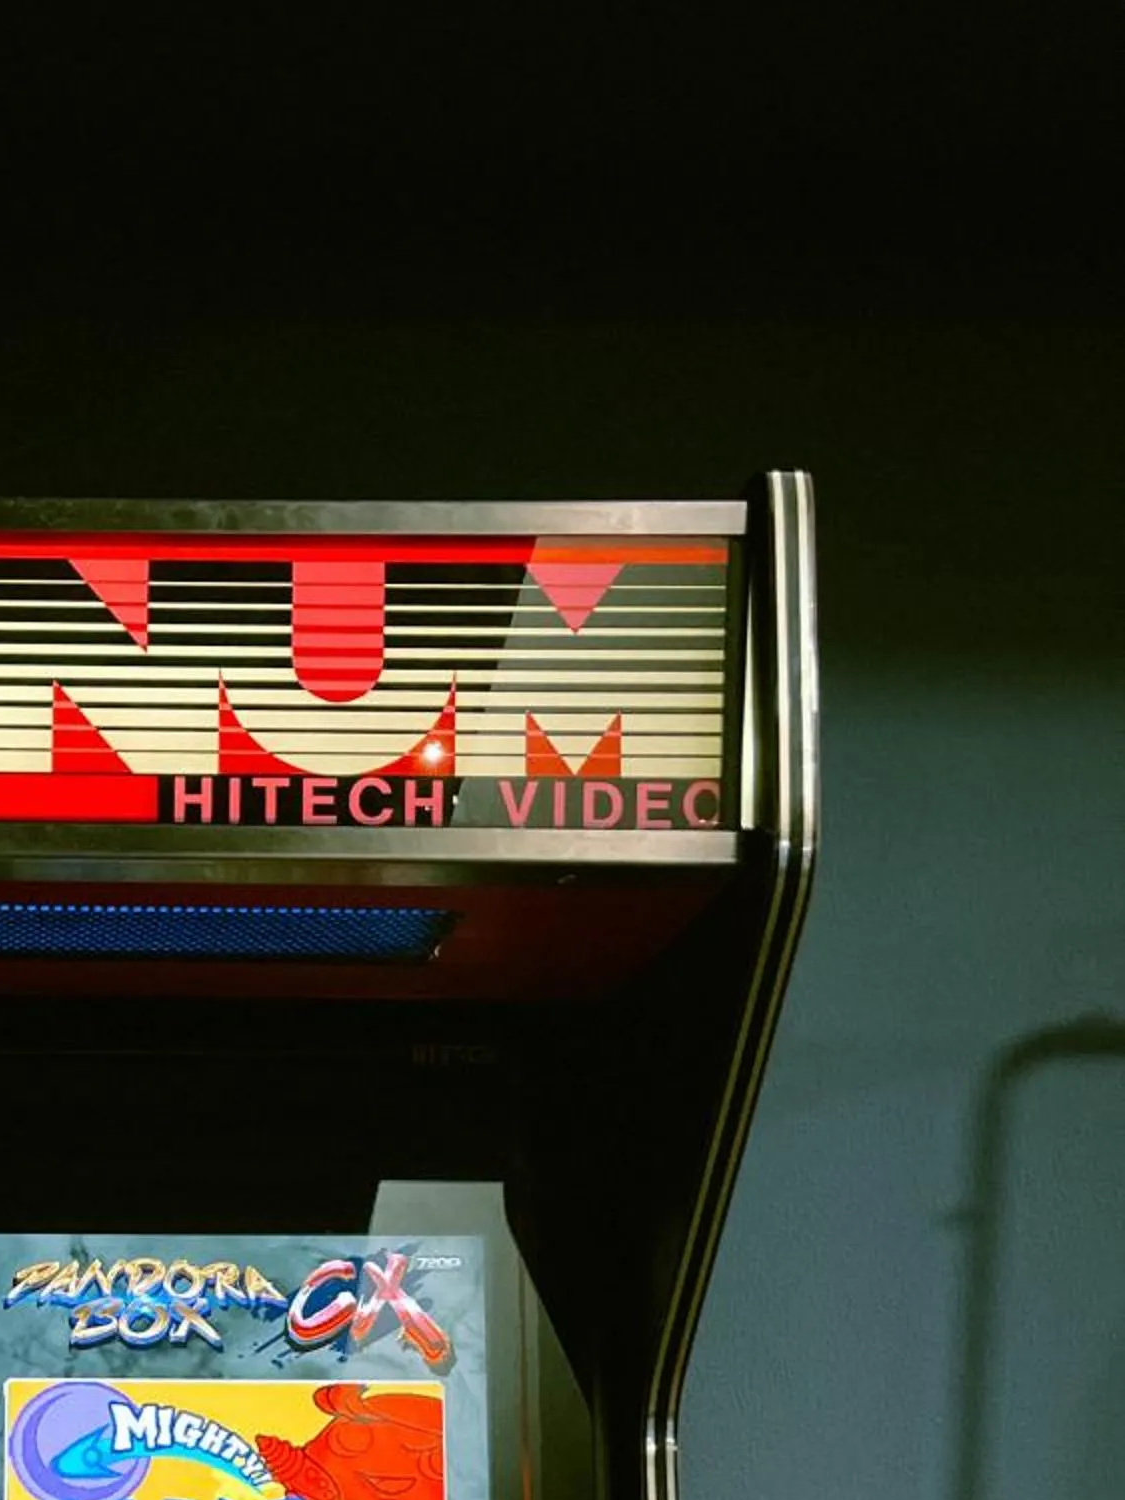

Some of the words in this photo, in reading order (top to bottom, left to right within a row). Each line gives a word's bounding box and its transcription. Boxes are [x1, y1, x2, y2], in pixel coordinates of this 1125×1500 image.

[175, 777, 444, 826] HITECH
[497, 780, 721, 830] VIDEO
[3, 1257, 288, 1309] PANDORA
[69, 1299, 223, 1351] BOX
